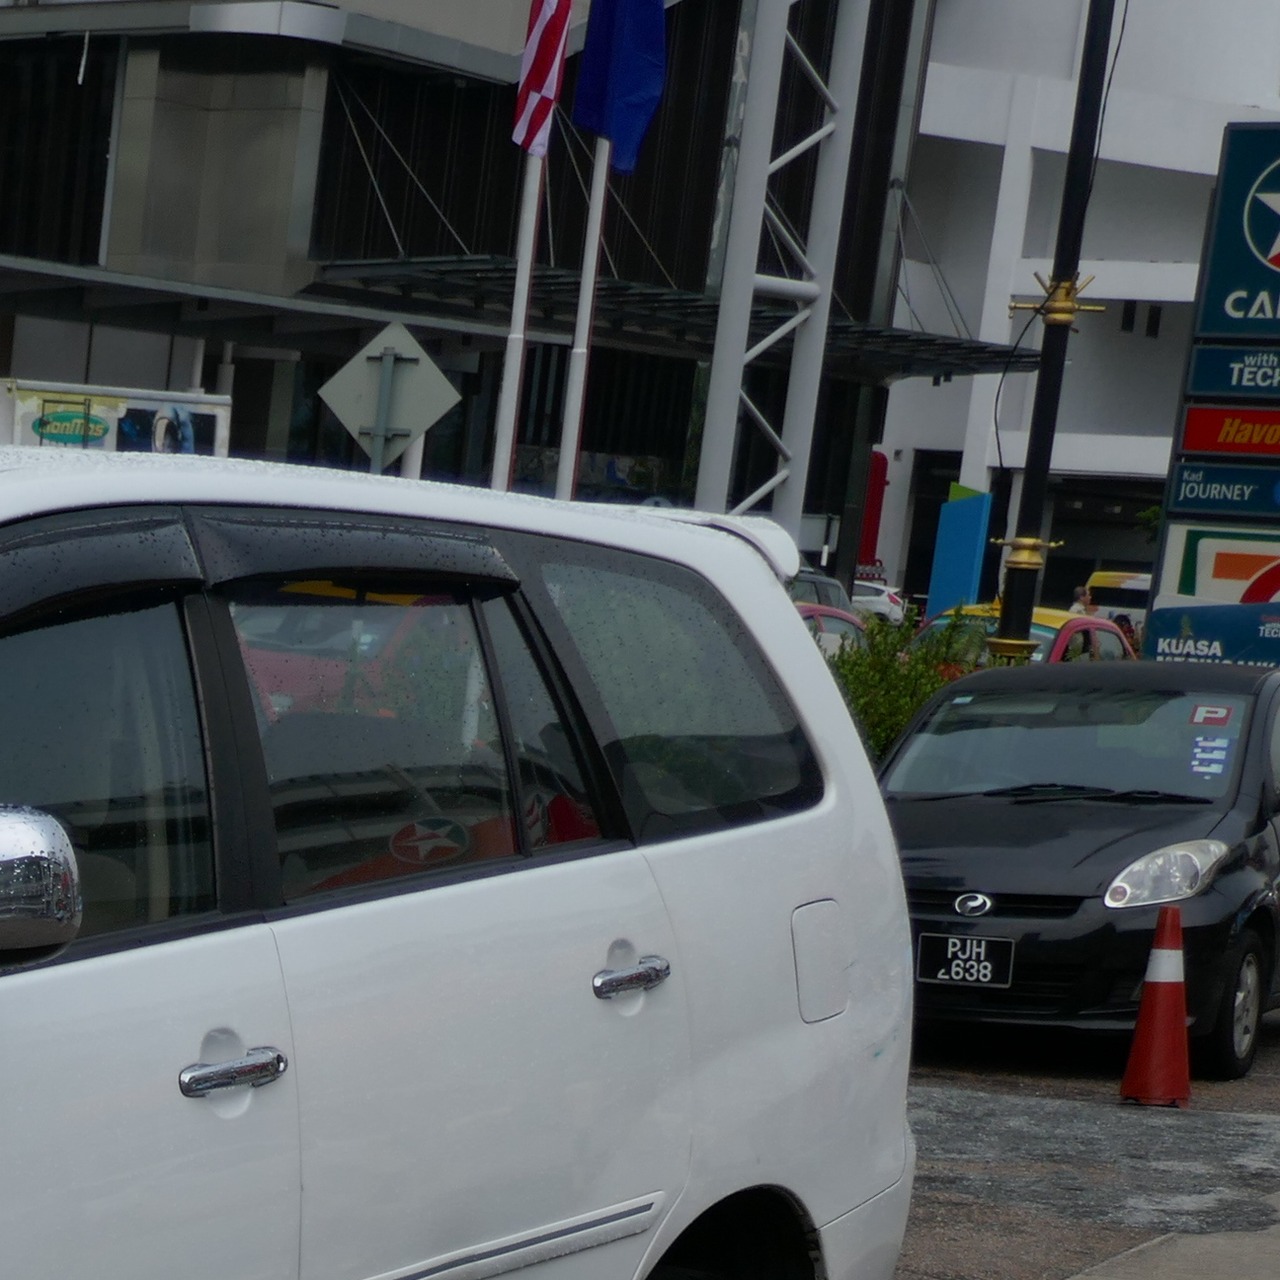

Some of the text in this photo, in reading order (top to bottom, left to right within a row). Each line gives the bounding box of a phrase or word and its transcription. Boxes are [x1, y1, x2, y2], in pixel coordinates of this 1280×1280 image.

[1224, 290, 1280, 319] CA
[1244, 353, 1278, 367] with
[1217, 418, 1280, 445] Havo
[1182, 469, 1203, 481] Kad
[1179, 482, 1253, 501] JOURNEY
[1258, 626, 1280, 638] TEC
[1156, 637, 1223, 657] KUASA
[1193, 706, 1228, 723] P
[947, 937, 986, 961] PJH
